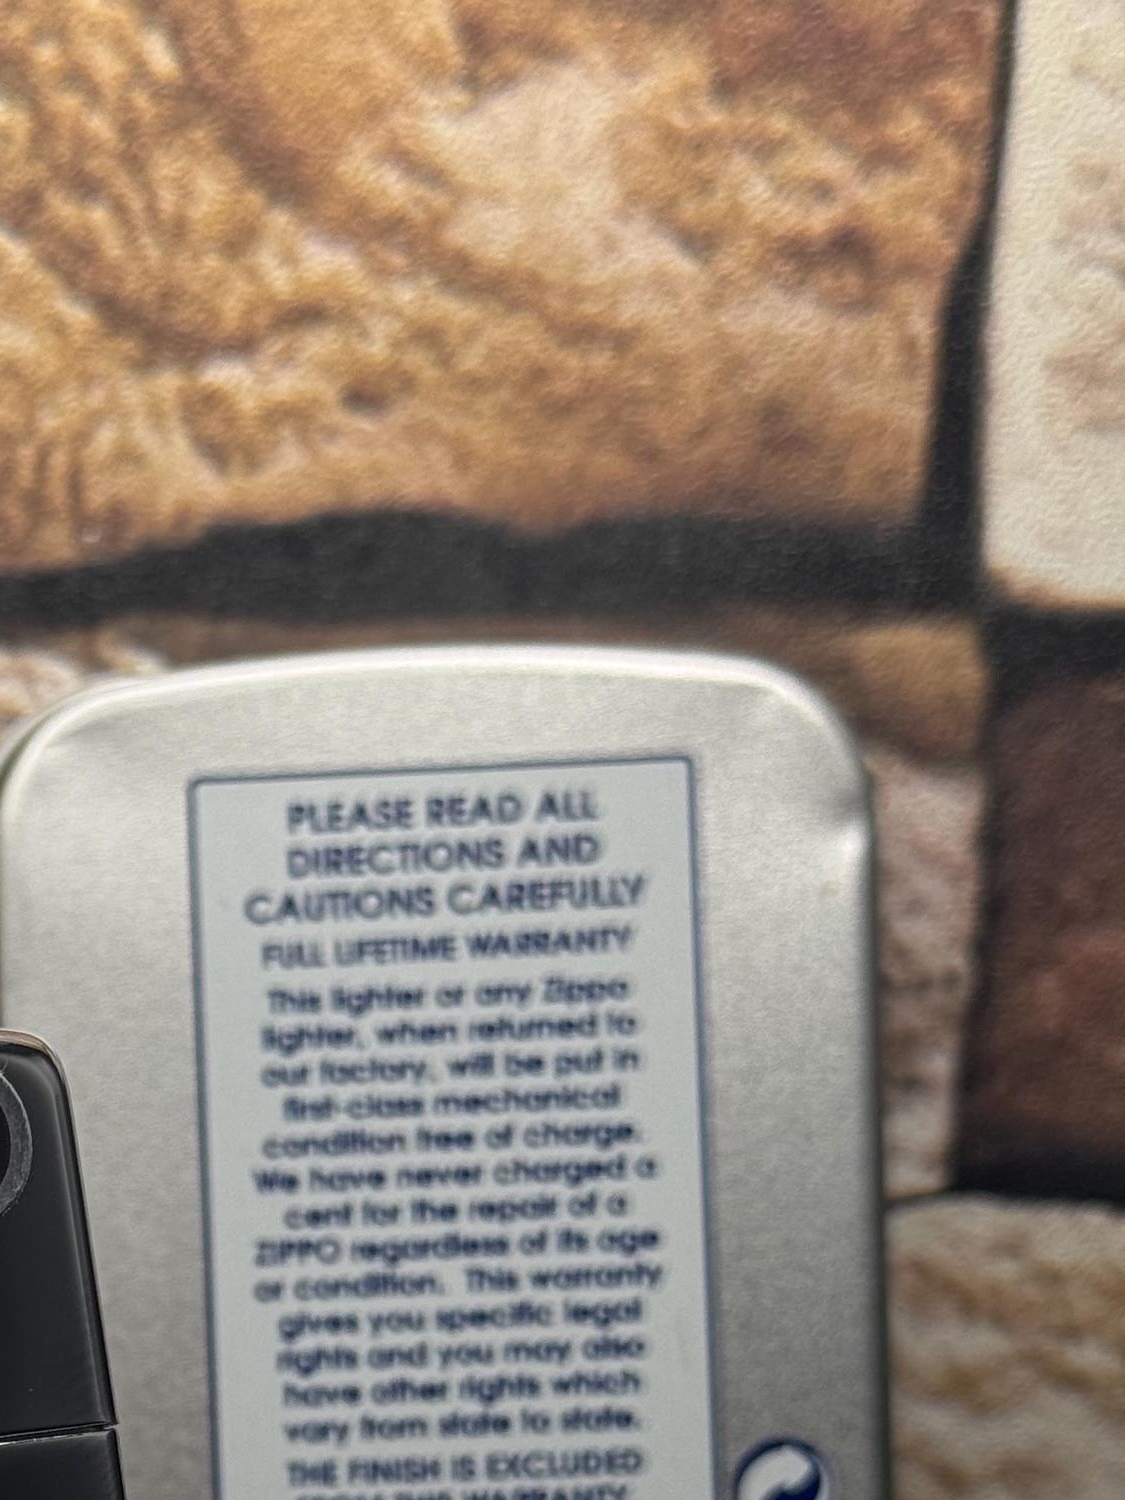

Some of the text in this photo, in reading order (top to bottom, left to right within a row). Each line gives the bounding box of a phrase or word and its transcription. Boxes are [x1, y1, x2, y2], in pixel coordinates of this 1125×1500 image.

[287, 789, 597, 833] PLEASE READ ALL
[287, 834, 601, 880] DIRECTIONS AND
[244, 874, 644, 924] CAUTIONS CAREFULLY
[261, 925, 632, 969] FULL LIFETIME WARRANTY
[267, 975, 628, 1018] This lighter or any Zippo
[260, 1010, 636, 1057] lighter, when returned to
[260, 1047, 638, 1088] our factory, will be put in
[283, 1082, 621, 1121] first-class mechanical
[262, 1122, 643, 1159] condition free of charge.
[253, 1154, 657, 1193] We have never charged a
[284, 1191, 627, 1230] cent for the repair of a
[254, 1227, 659, 1268] ZIPPO regardless of its age
[253, 1262, 663, 1302] or condition. This warranty
[278, 1297, 642, 1343] gives you specific legal
[277, 1336, 645, 1377] rights and you may also
[283, 1369, 642, 1407] have other rights which
[285, 1406, 642, 1447] vary from state to state.
[287, 1447, 644, 1487] THE FINISH IS EXCLUDED
